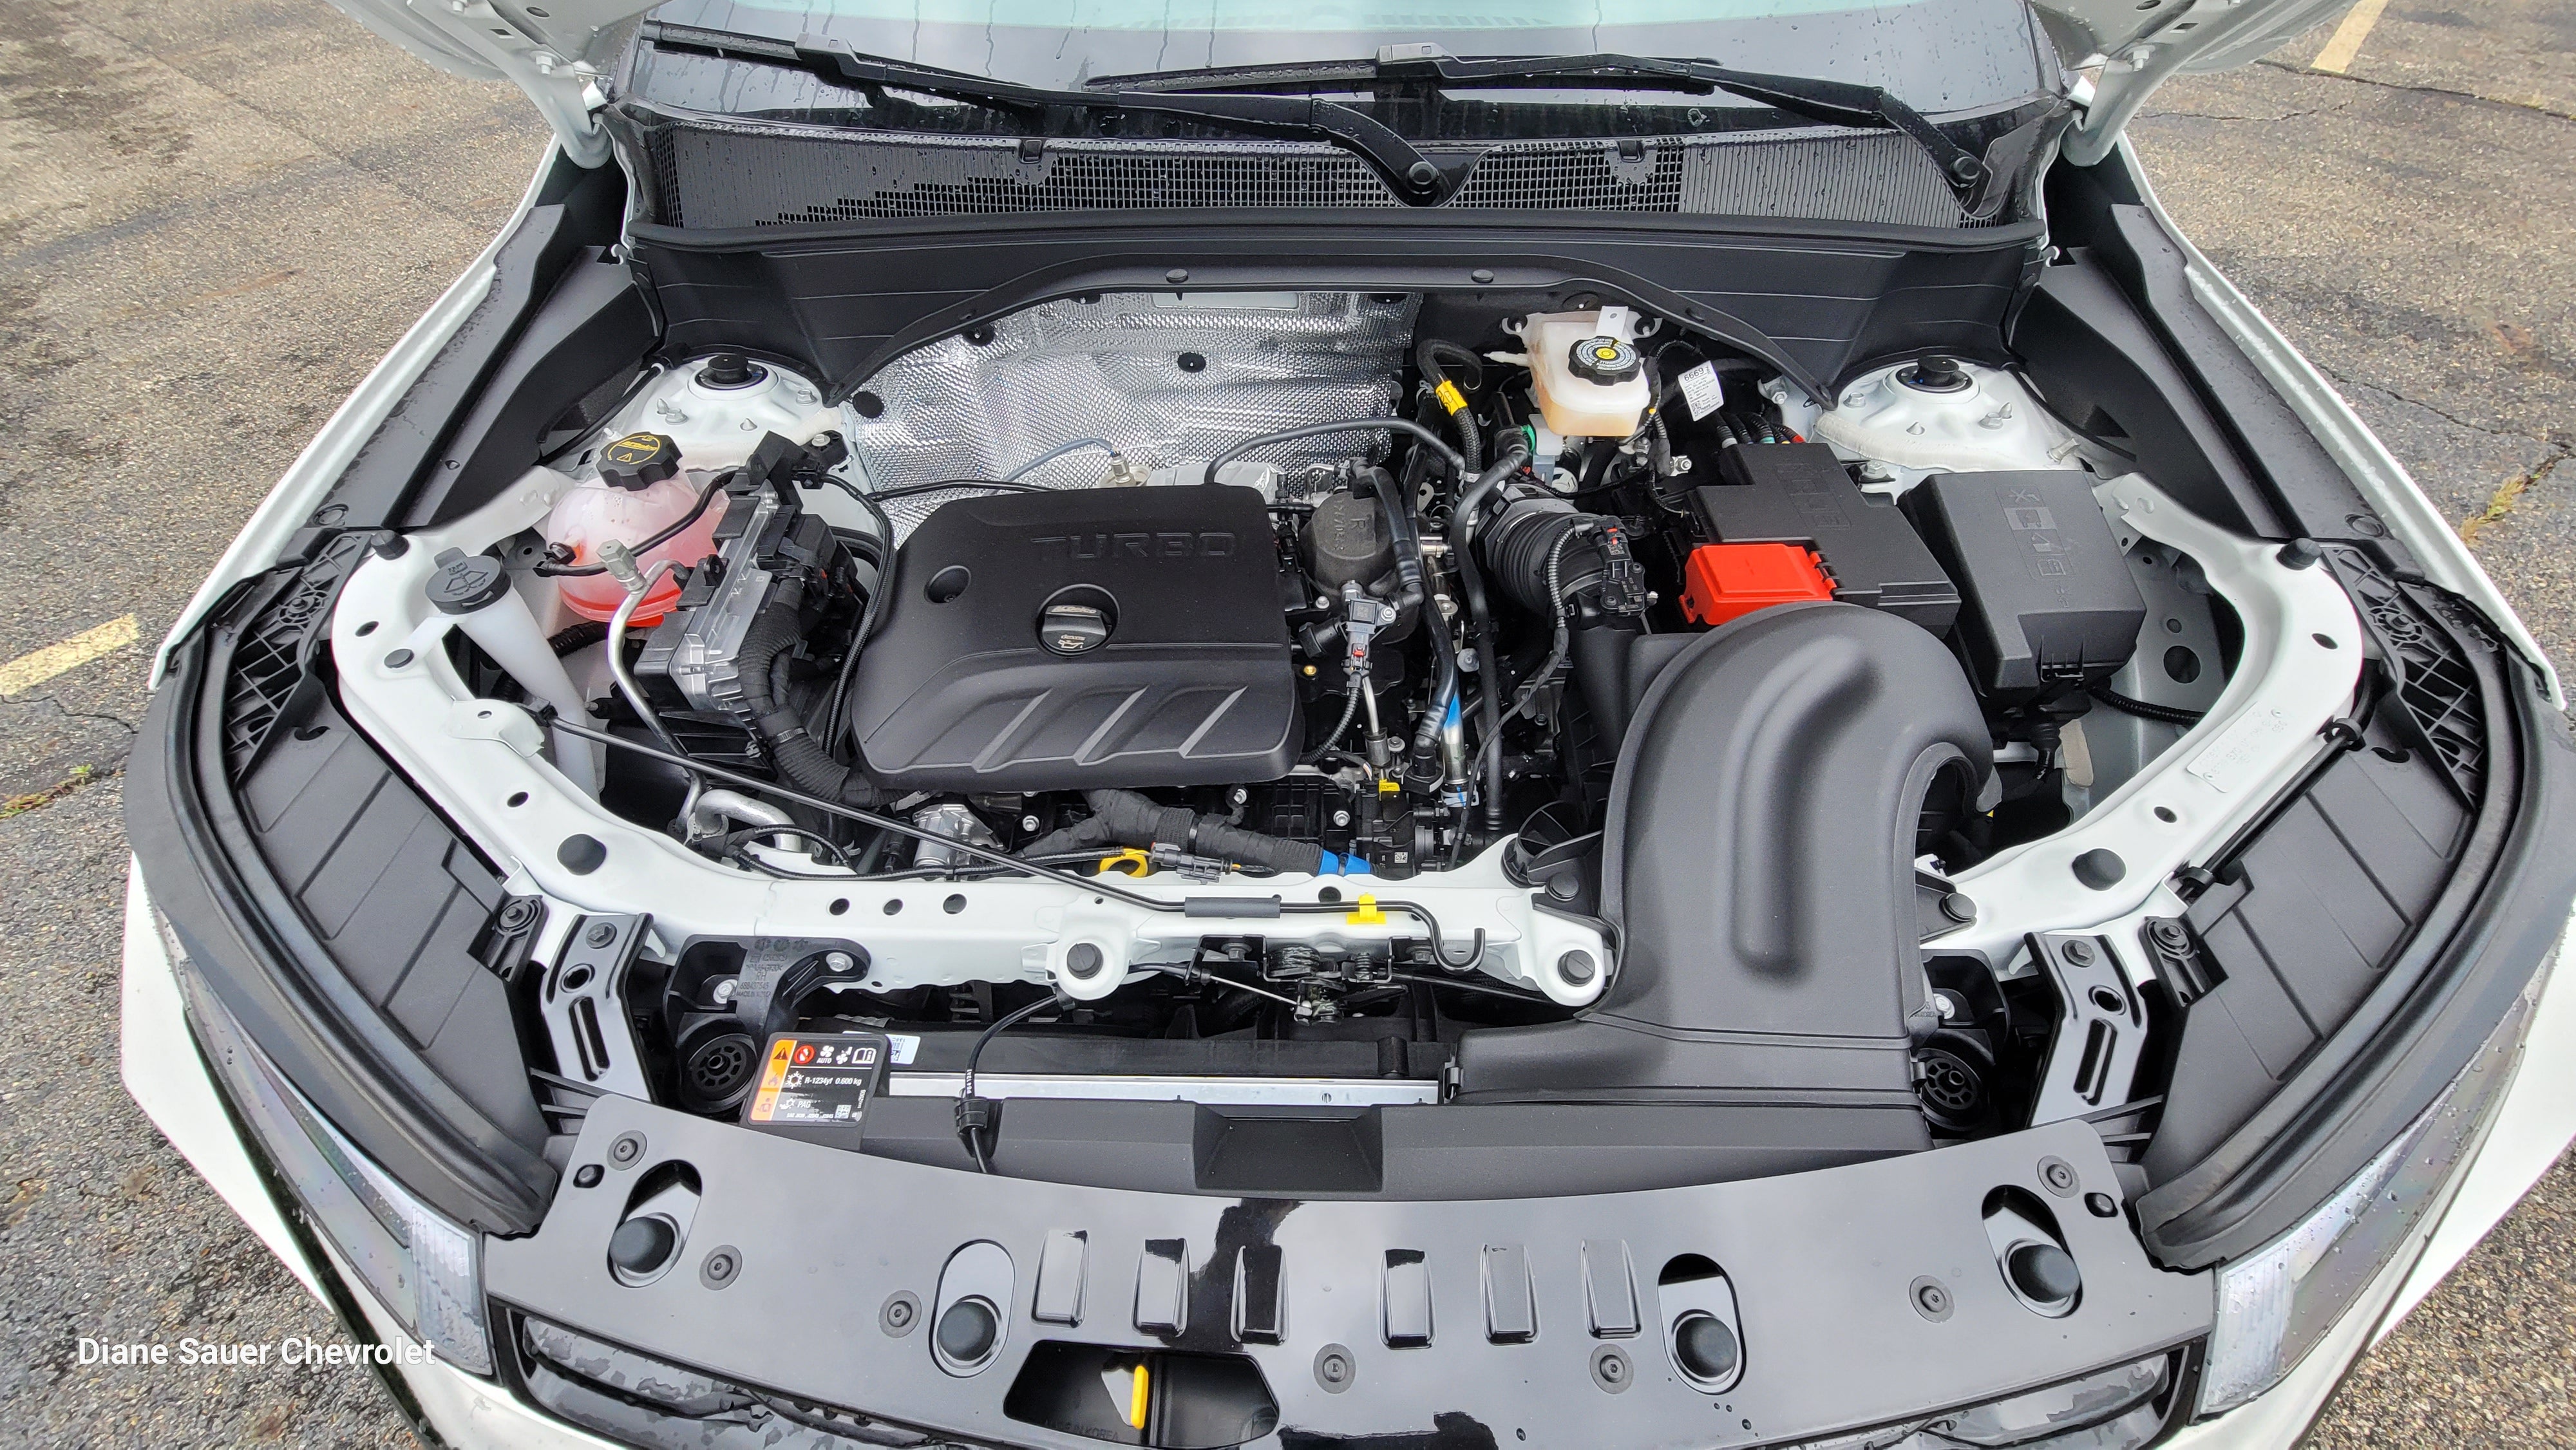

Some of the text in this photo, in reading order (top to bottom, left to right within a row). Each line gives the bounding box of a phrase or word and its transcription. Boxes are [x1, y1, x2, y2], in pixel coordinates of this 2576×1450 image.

[1684, 367, 1705, 382] 6669
[1030, 532, 1236, 559] TURBO
[804, 1077, 833, 1086] R-1234yf
[853, 1078, 862, 1086] kg
[1085, 1427, 1119, 1440] KOREA
